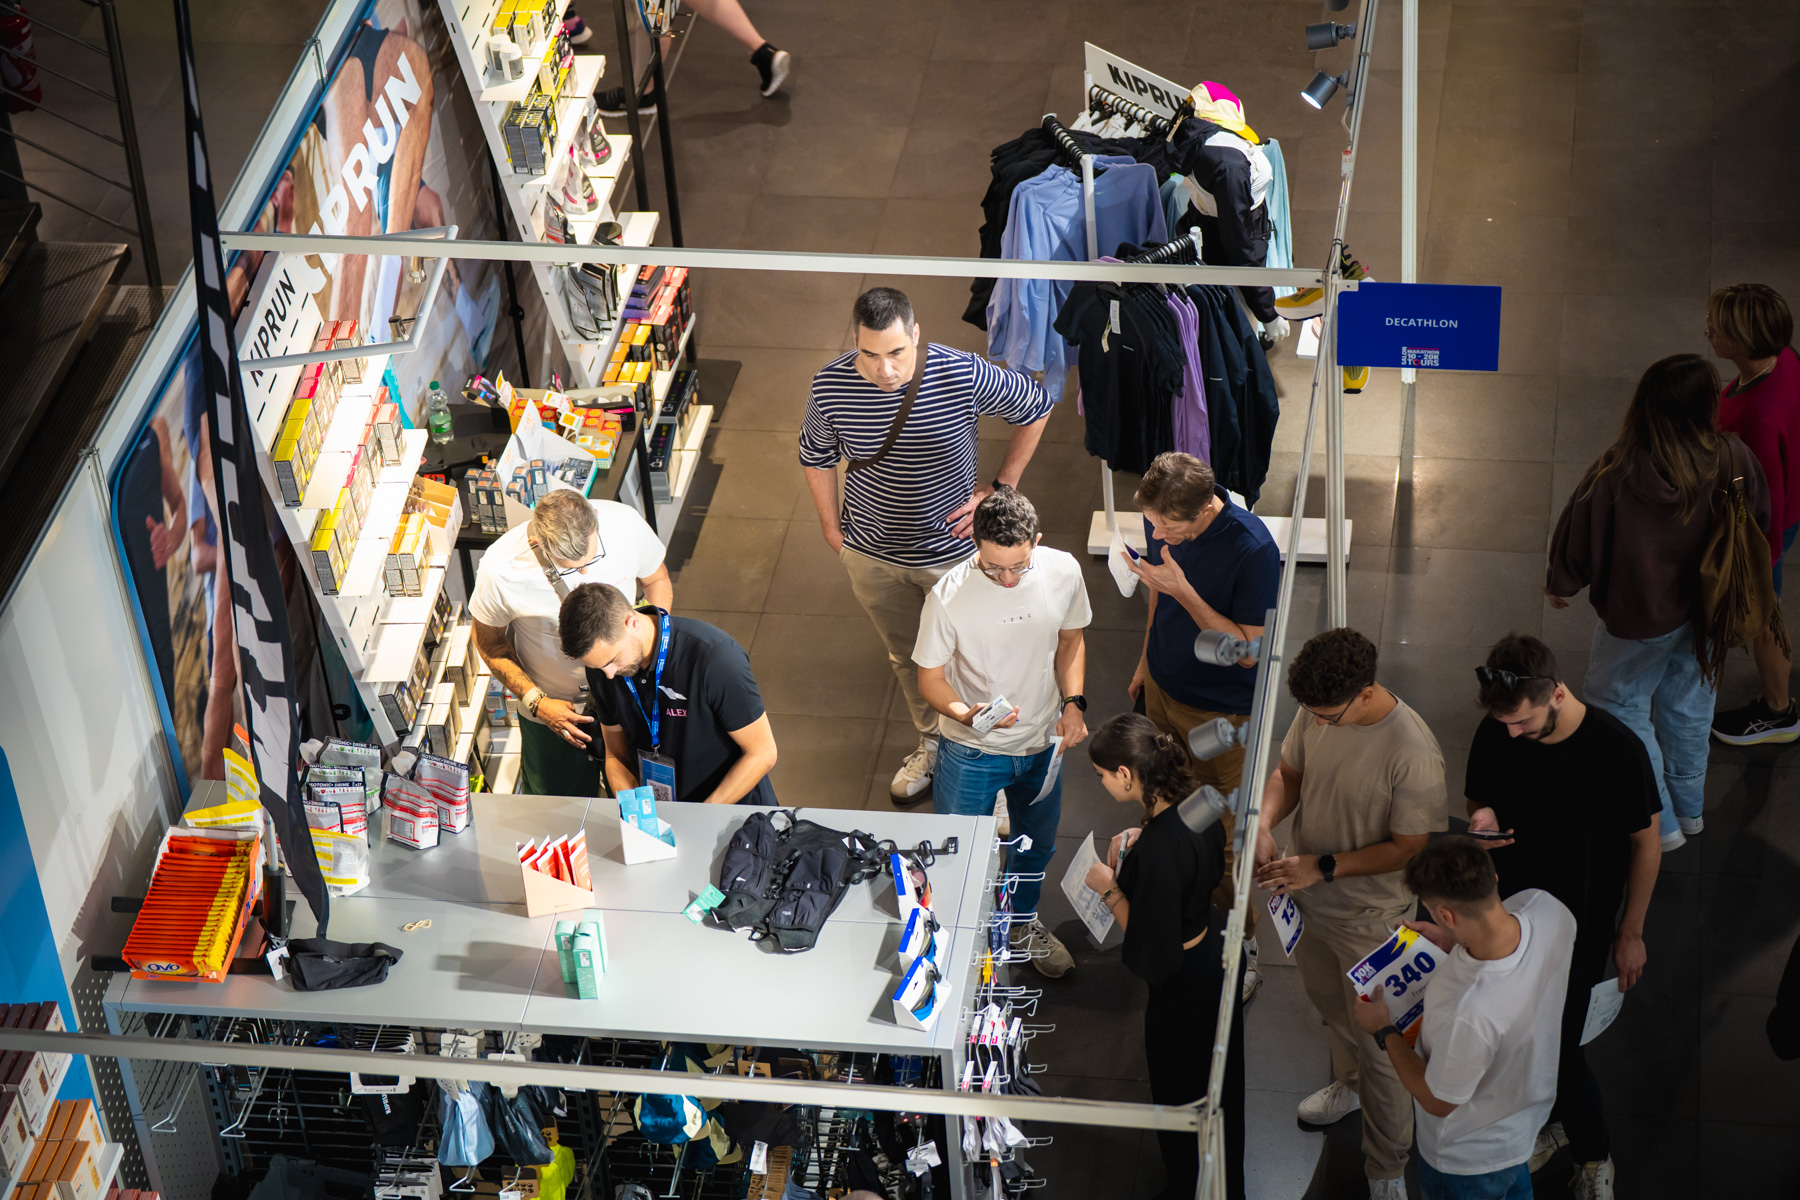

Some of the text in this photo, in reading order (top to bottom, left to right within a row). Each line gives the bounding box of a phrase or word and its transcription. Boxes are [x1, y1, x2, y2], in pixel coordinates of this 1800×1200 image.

[1106, 62, 1186, 114] KIPRU
[304, 51, 422, 294] IPRUN
[1385, 317, 1458, 328] DECATHLON
[666, 707, 688, 717] ALEX
[1354, 961, 1374, 981] 10K
[1384, 951, 1436, 997] 340
